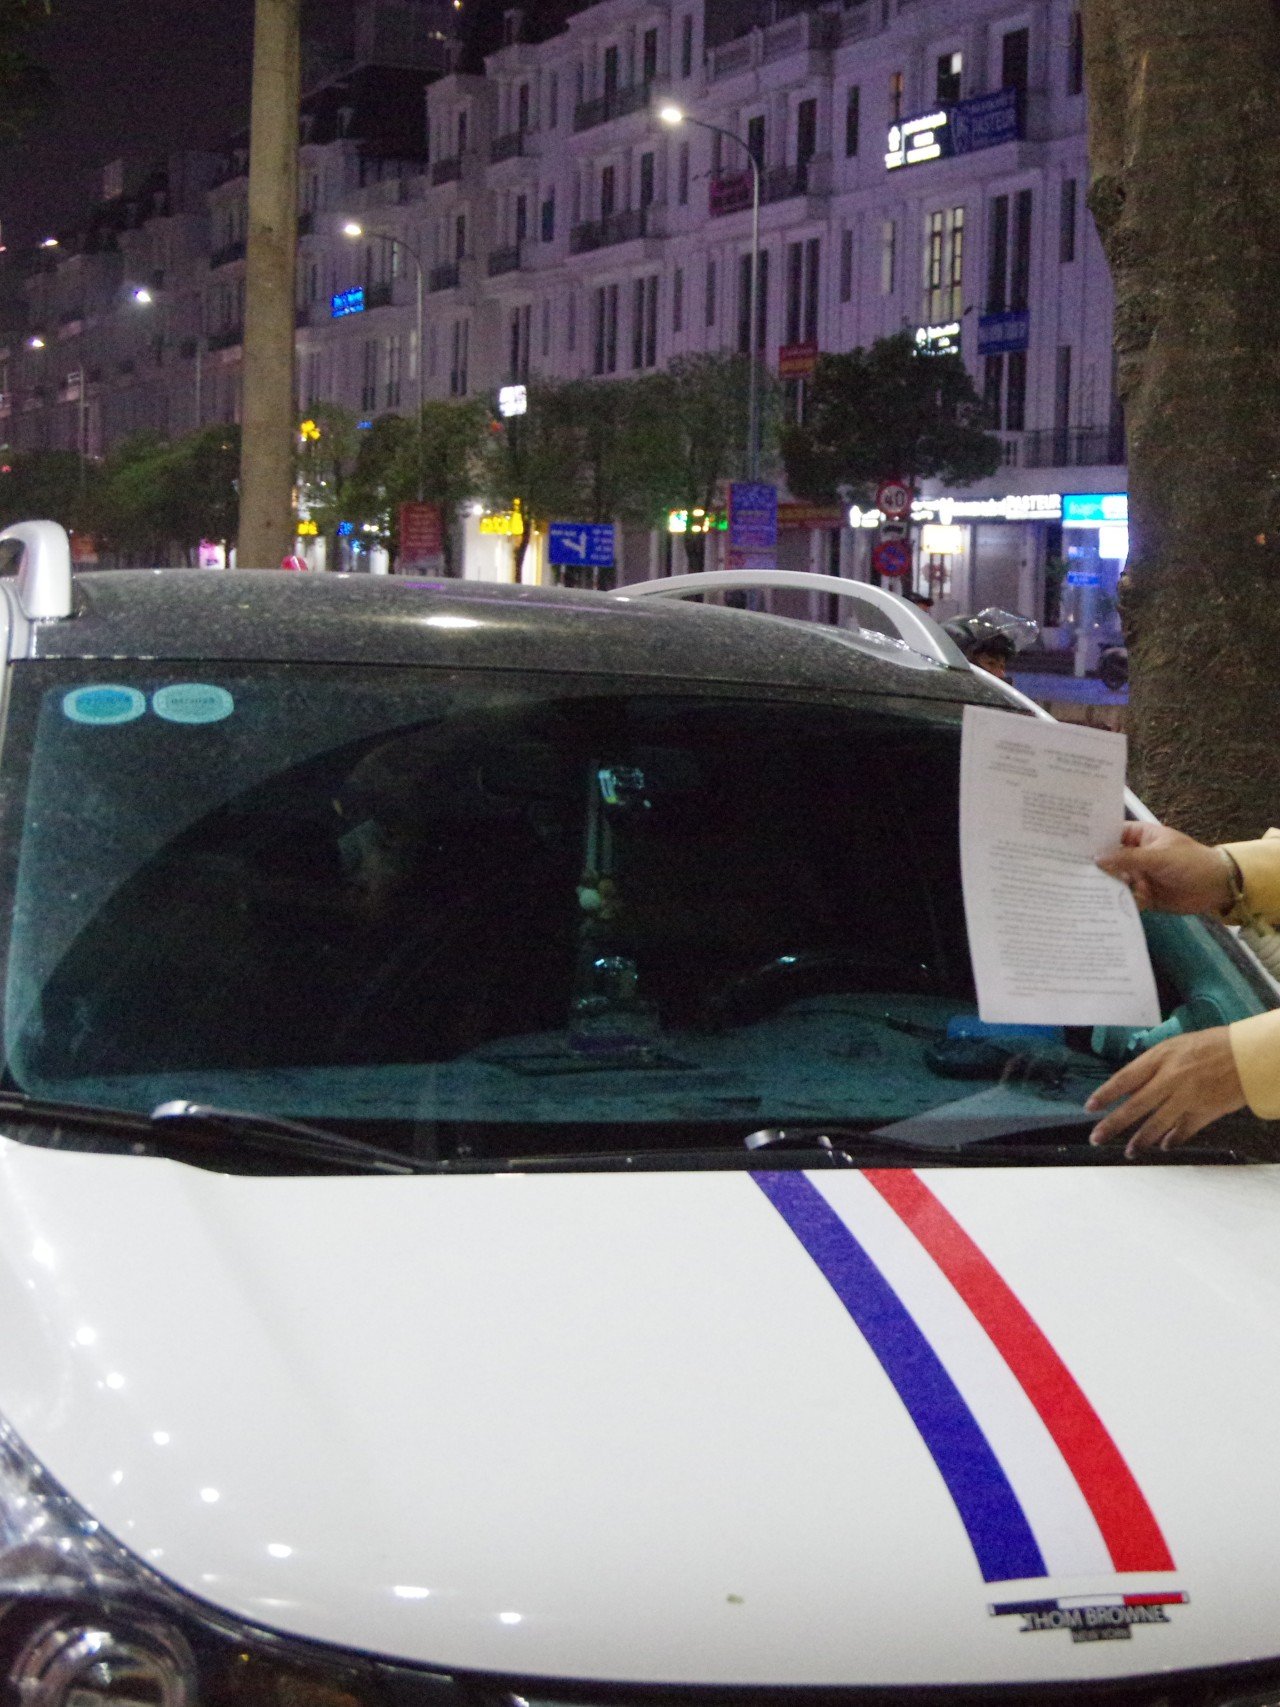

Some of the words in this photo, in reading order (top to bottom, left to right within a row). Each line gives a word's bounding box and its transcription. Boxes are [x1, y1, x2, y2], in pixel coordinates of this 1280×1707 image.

[885, 490, 905, 508] 40
[1022, 1608, 1083, 1631] THOM
[1084, 1604, 1167, 1627] BROWNE
